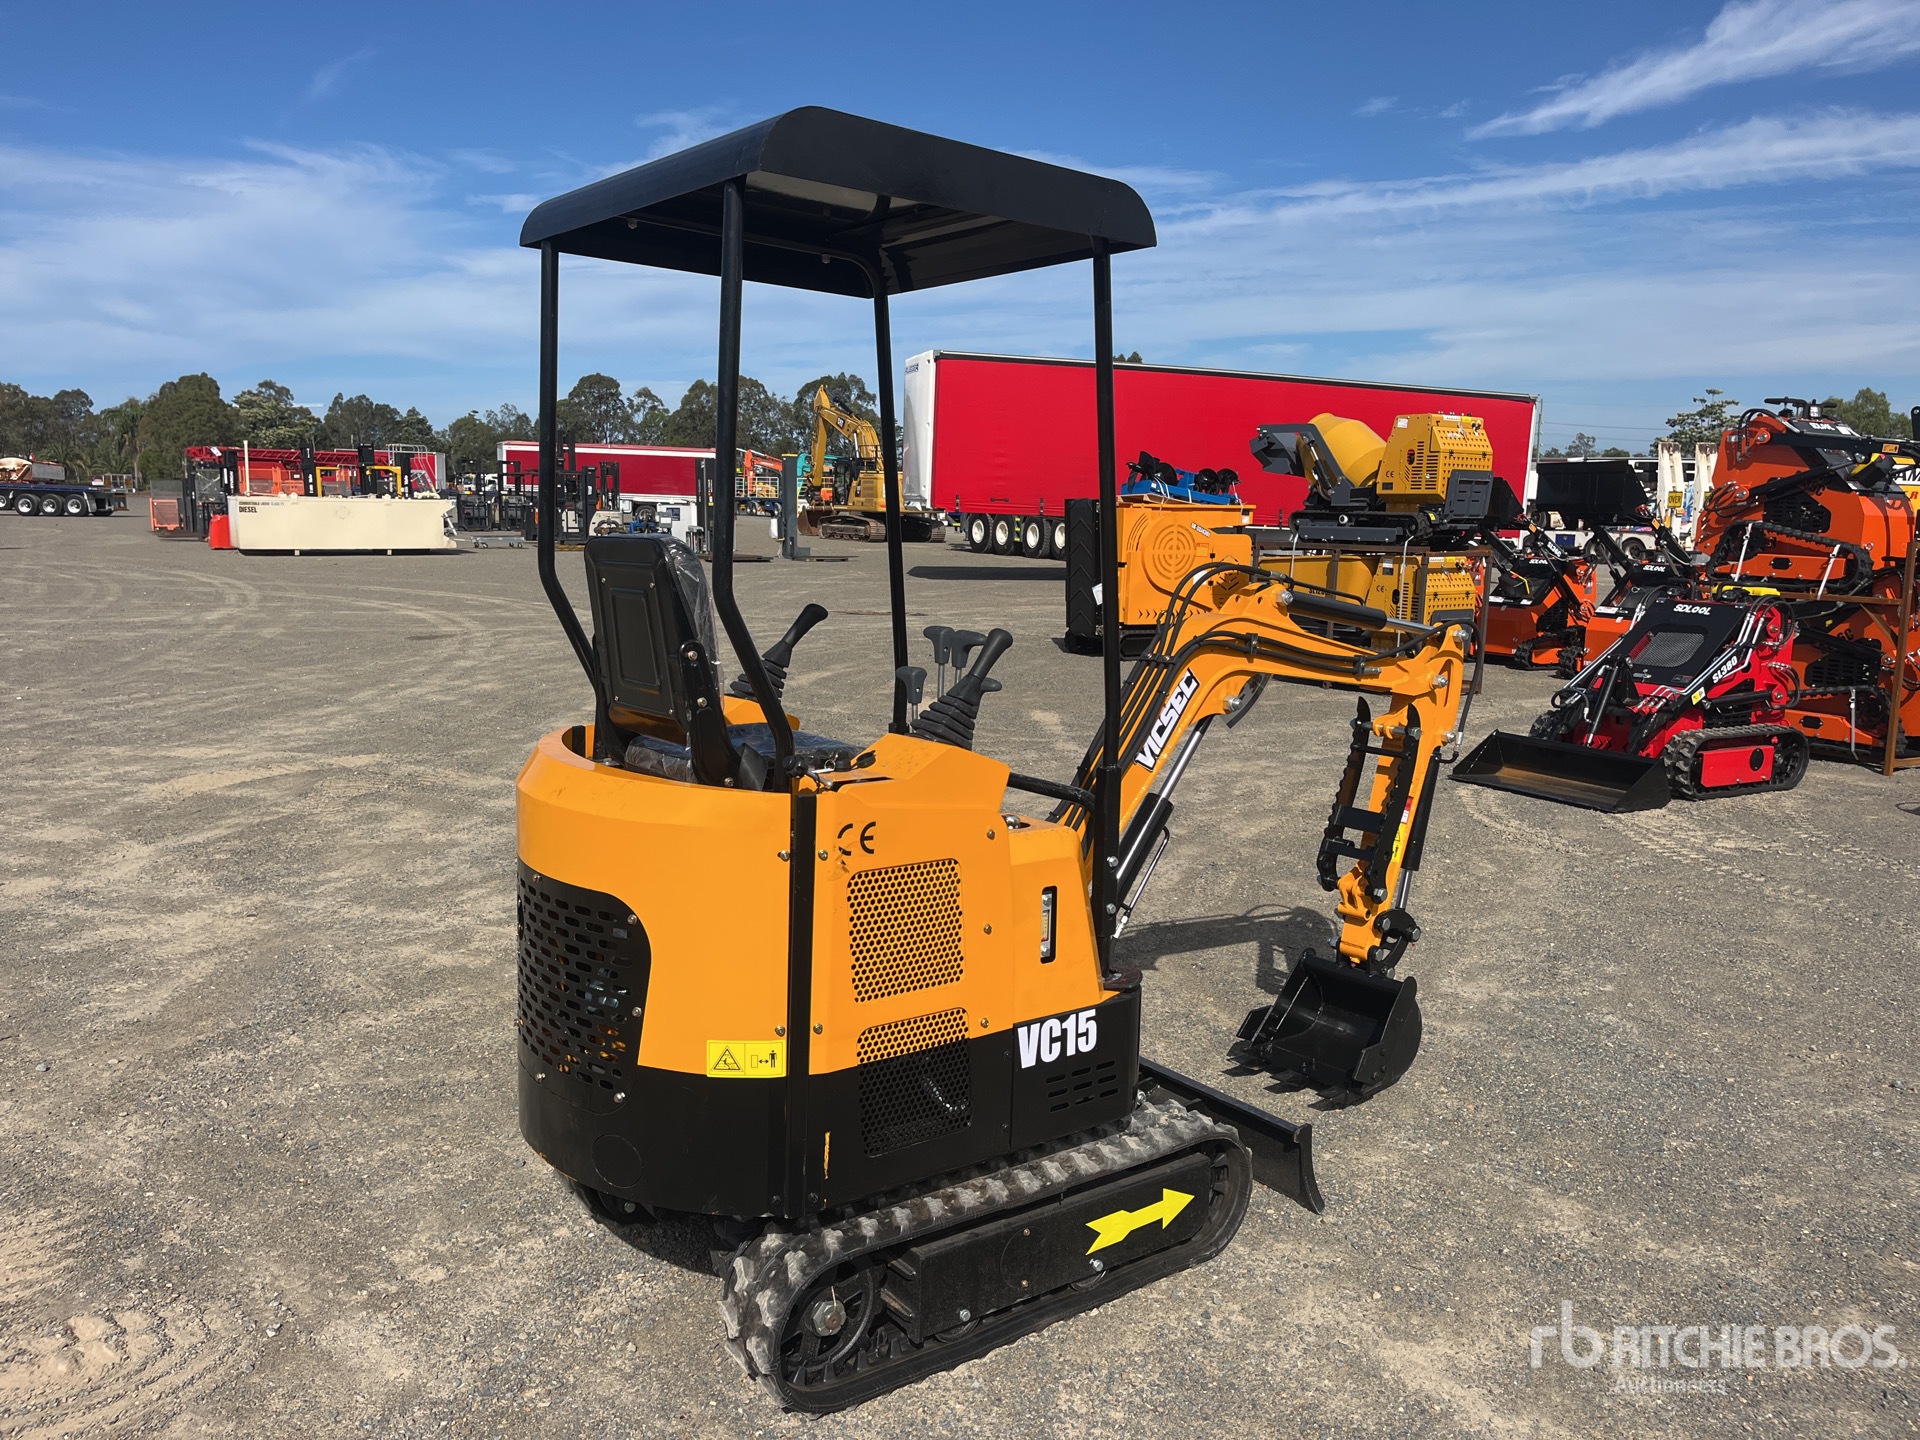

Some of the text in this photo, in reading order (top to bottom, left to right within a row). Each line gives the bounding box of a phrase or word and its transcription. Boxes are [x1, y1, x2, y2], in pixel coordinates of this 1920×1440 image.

[1668, 495, 1681, 504] OVER
[1673, 603, 1712, 616] SDLOOL
[1712, 655, 1738, 684] SL380
[1133, 667, 1200, 772] VICSEC
[1017, 1008, 1098, 1069] VC15
